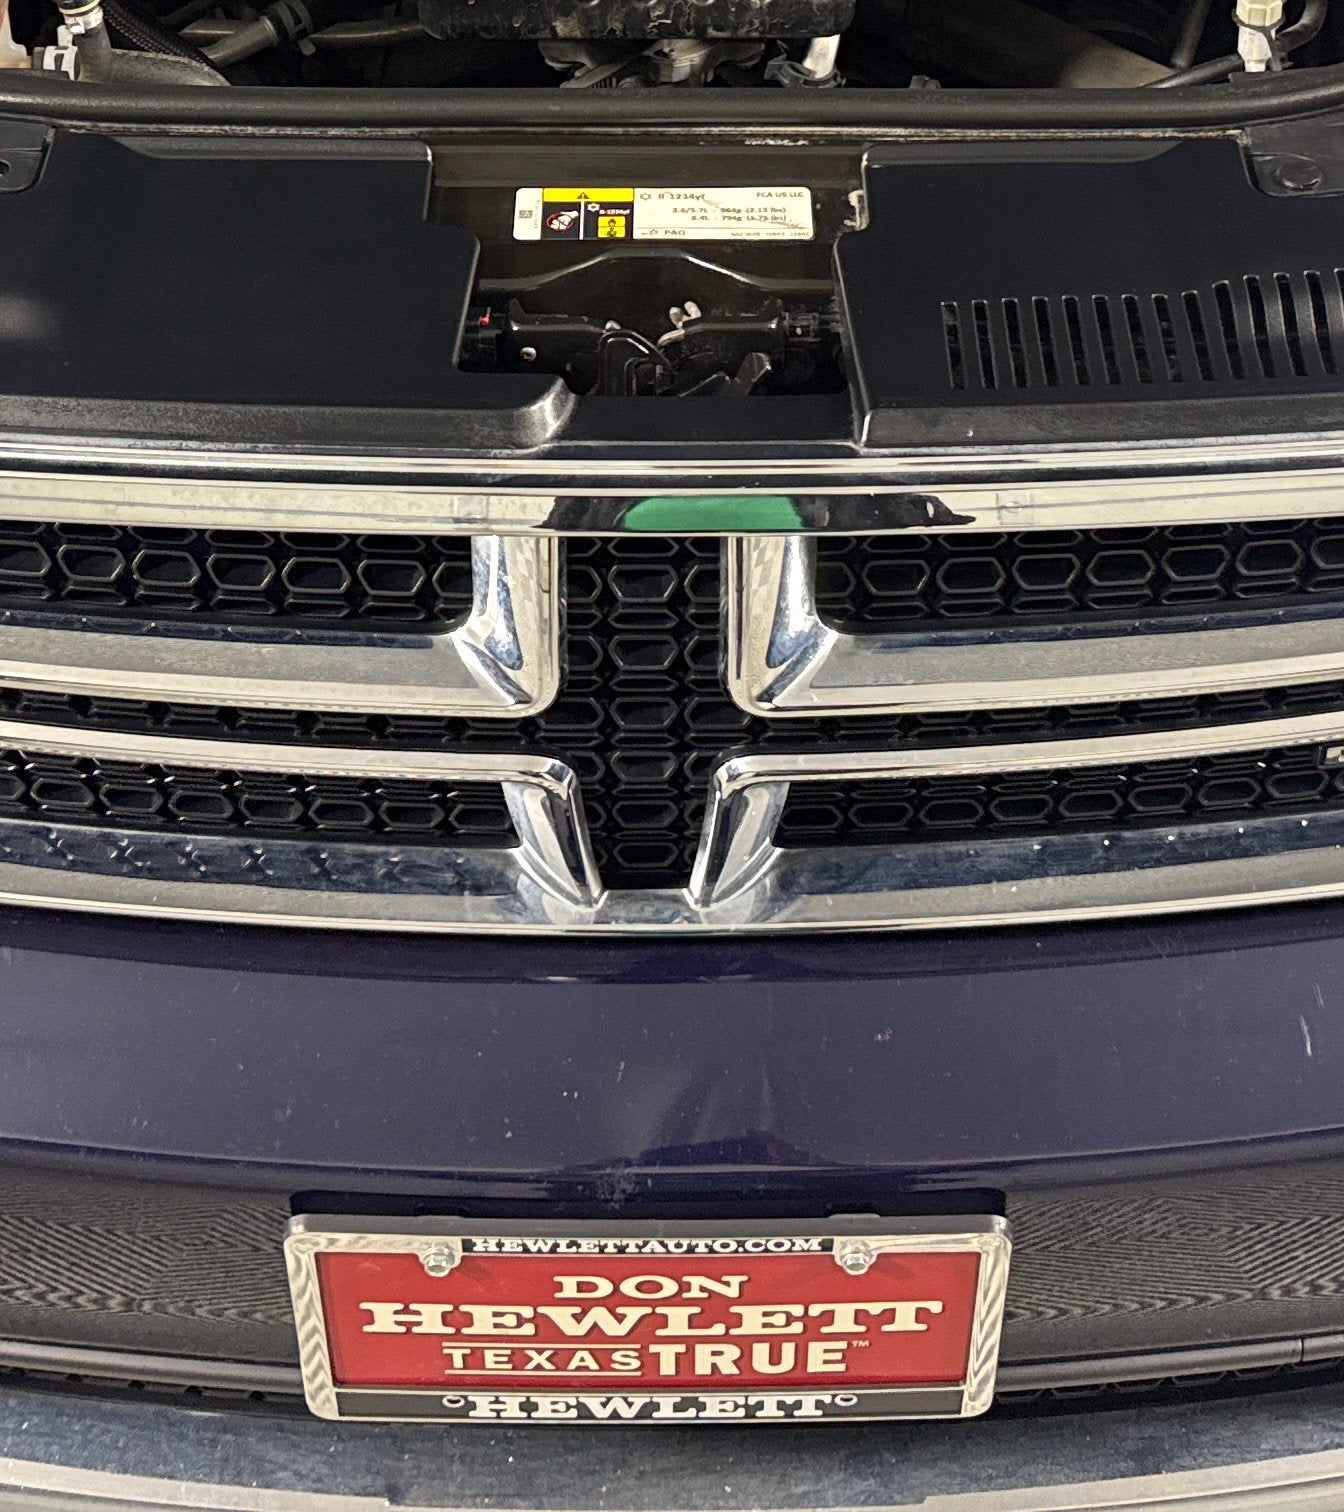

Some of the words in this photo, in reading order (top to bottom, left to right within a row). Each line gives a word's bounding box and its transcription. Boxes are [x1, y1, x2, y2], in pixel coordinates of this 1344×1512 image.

[472, 1238, 823, 1254] HEWLETTAUTO.COM
[553, 1274, 749, 1300] DON
[359, 1300, 944, 1337] HEWLETT
[467, 1395, 833, 1419] HEWLETT
